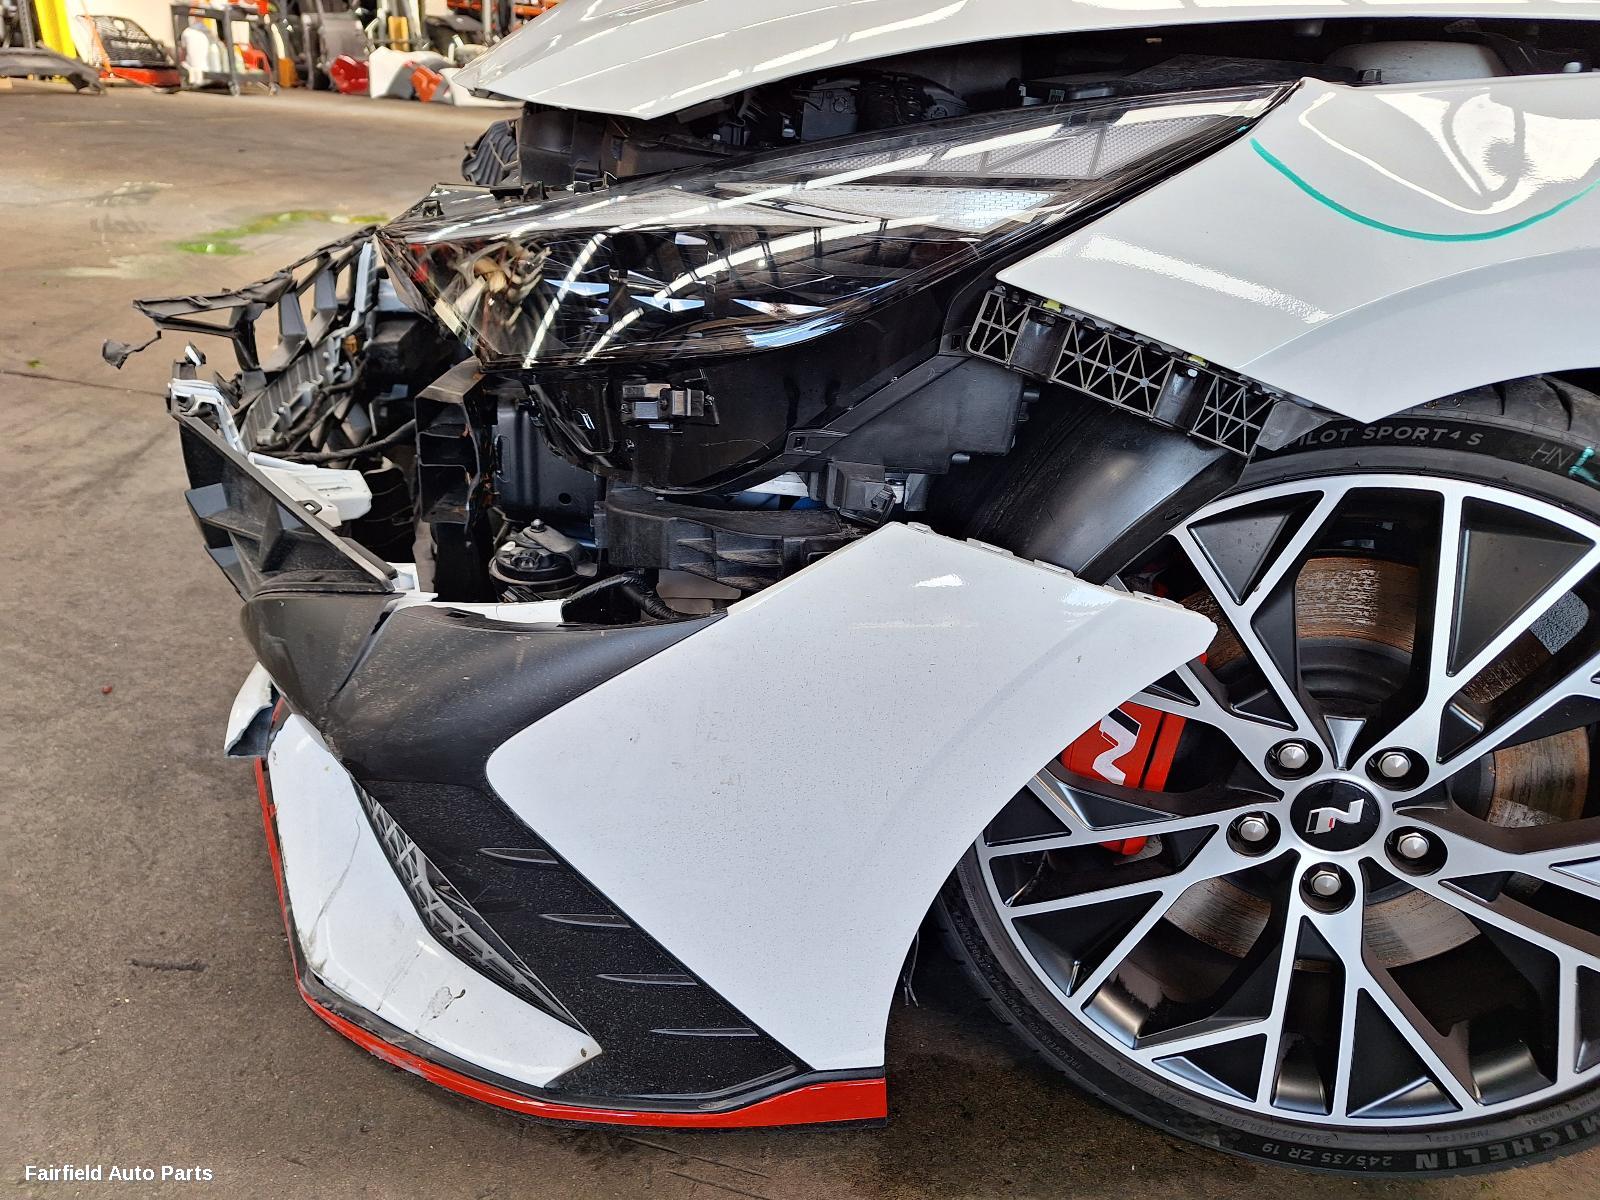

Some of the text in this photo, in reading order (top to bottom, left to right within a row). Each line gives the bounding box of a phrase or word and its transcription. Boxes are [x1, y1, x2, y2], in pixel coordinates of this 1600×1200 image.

[1284, 428, 1354, 448] ILOT
[1262, 1112, 1600, 1170] MICHELIN 245/35 ZR 19
